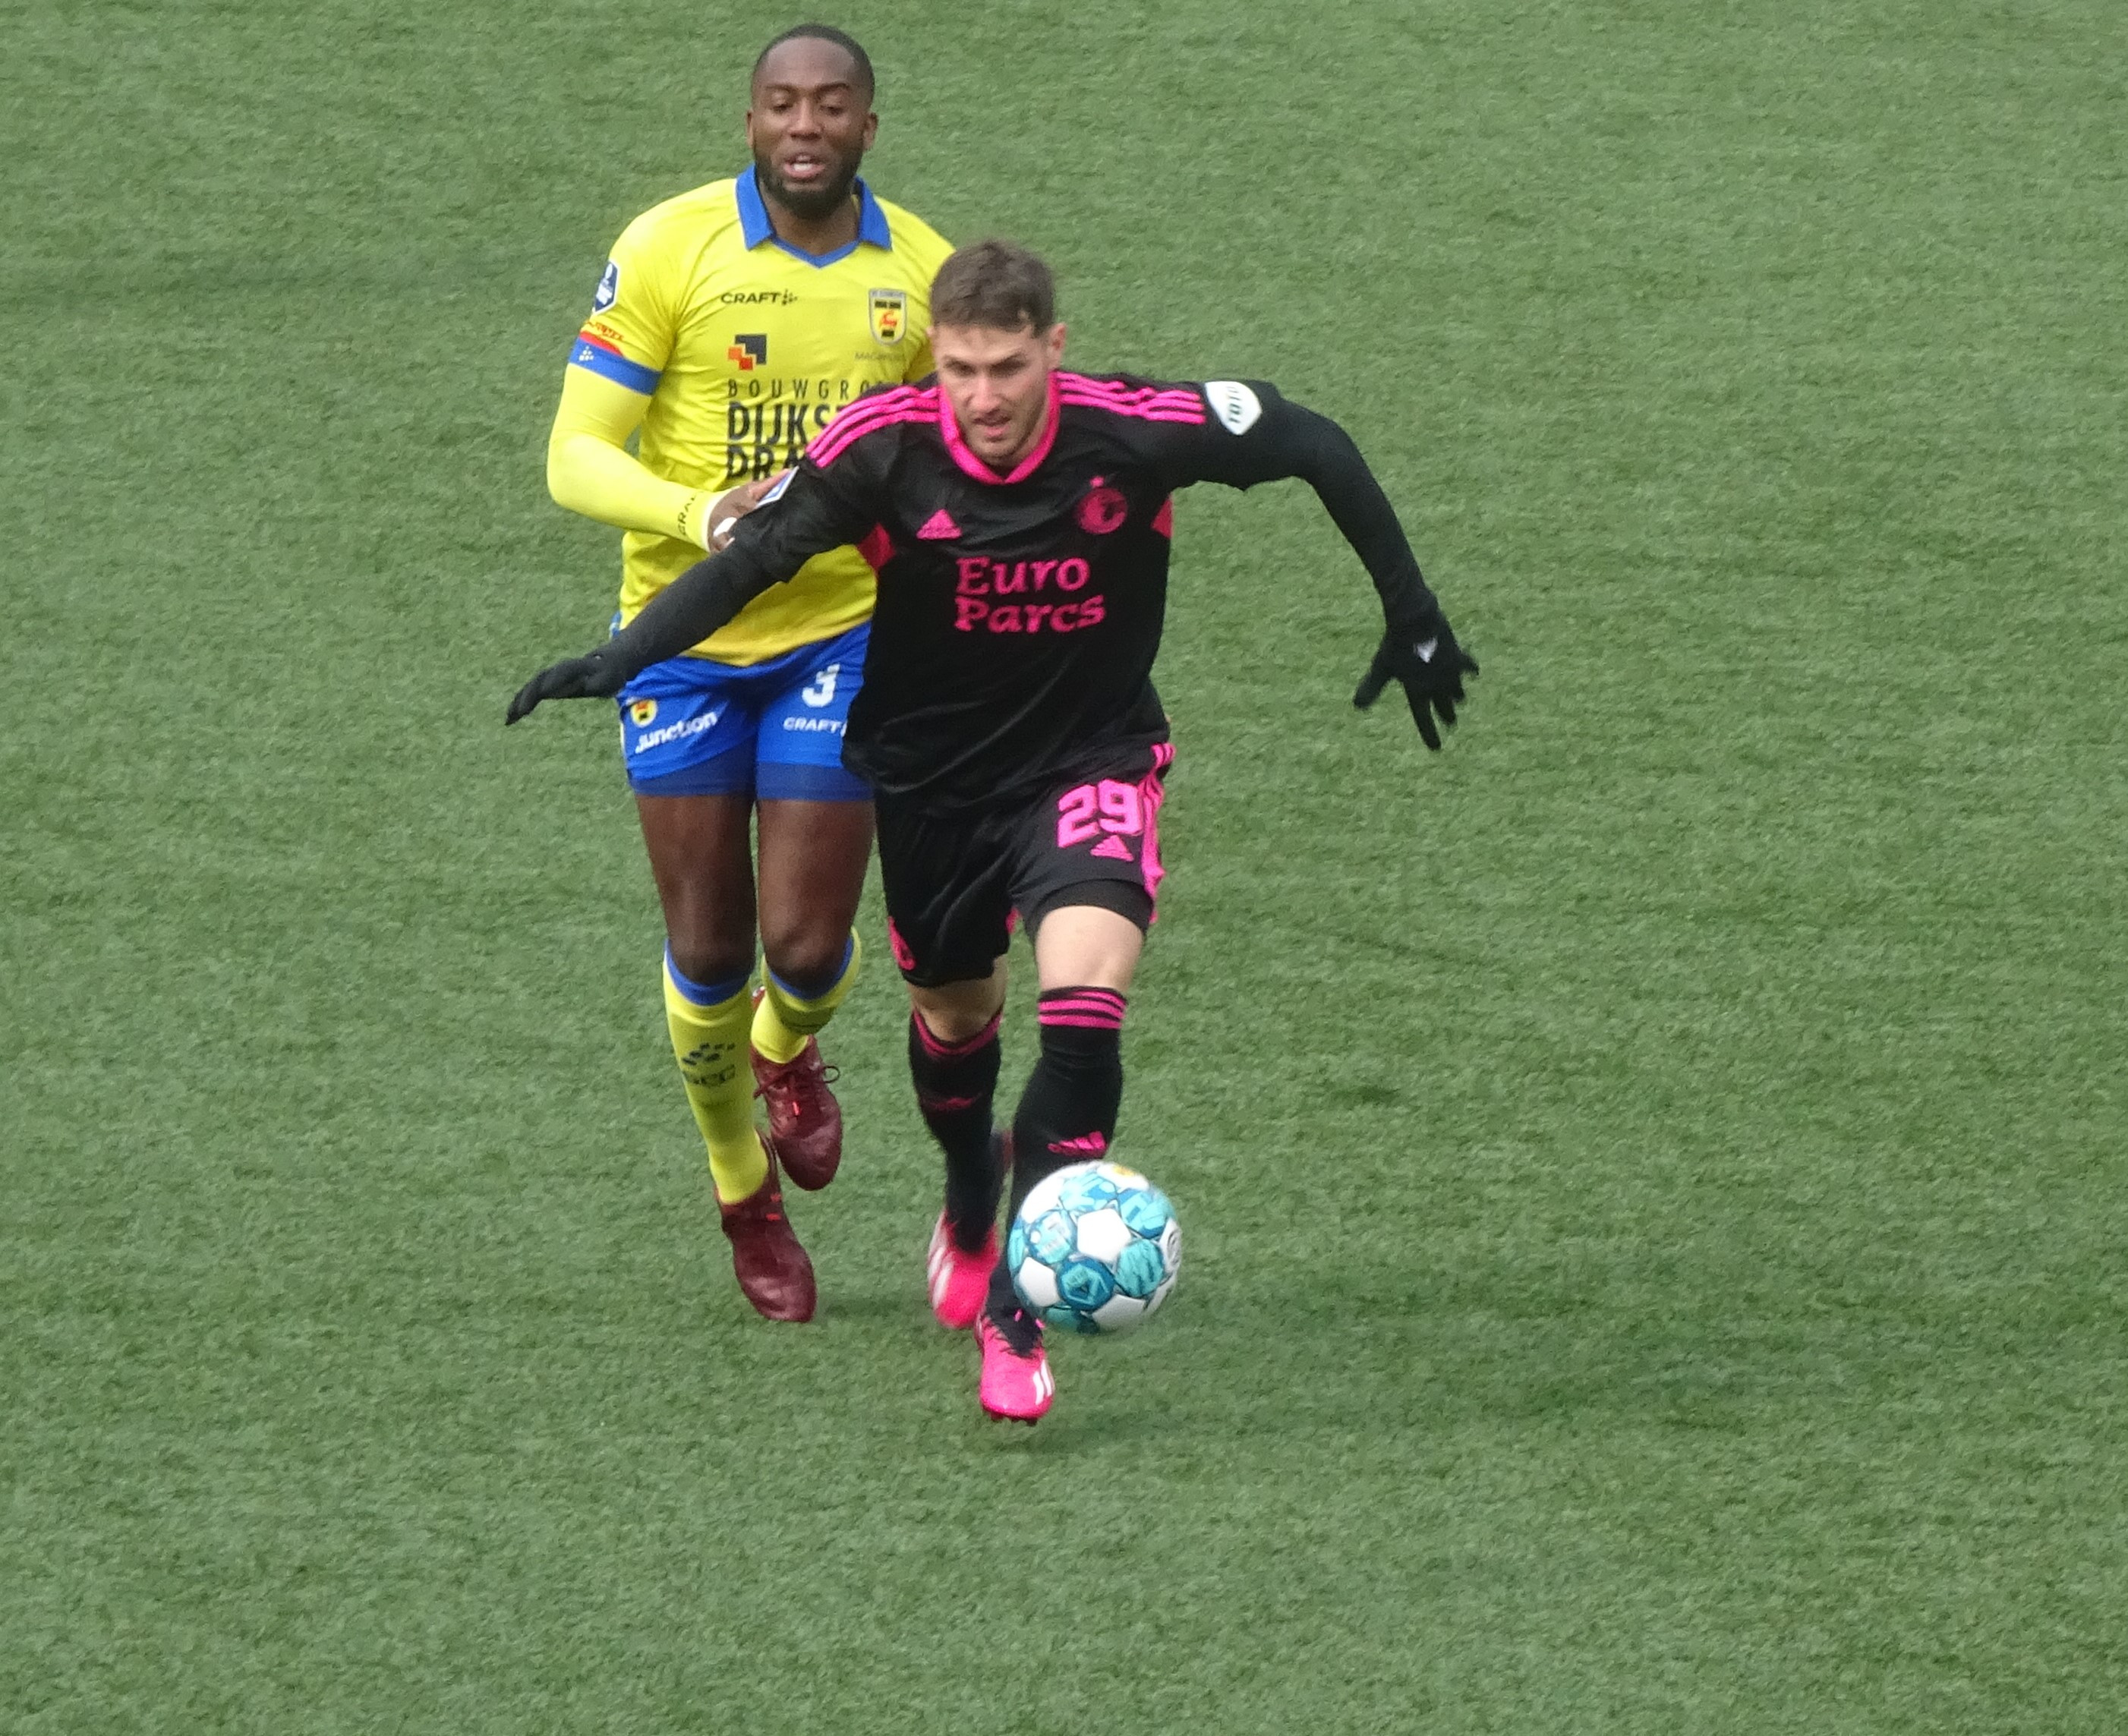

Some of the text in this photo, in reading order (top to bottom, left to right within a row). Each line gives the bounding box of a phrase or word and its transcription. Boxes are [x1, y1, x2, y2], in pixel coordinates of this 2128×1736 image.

[720, 291, 782, 304] CRAFT
[728, 378, 871, 400] BOUWGRO
[727, 444, 805, 480] DRA
[955, 556, 1091, 595] Euro
[954, 594, 1106, 634] Parcs
[783, 717, 842, 734] CRAFT
[1057, 778, 1144, 849] 29
